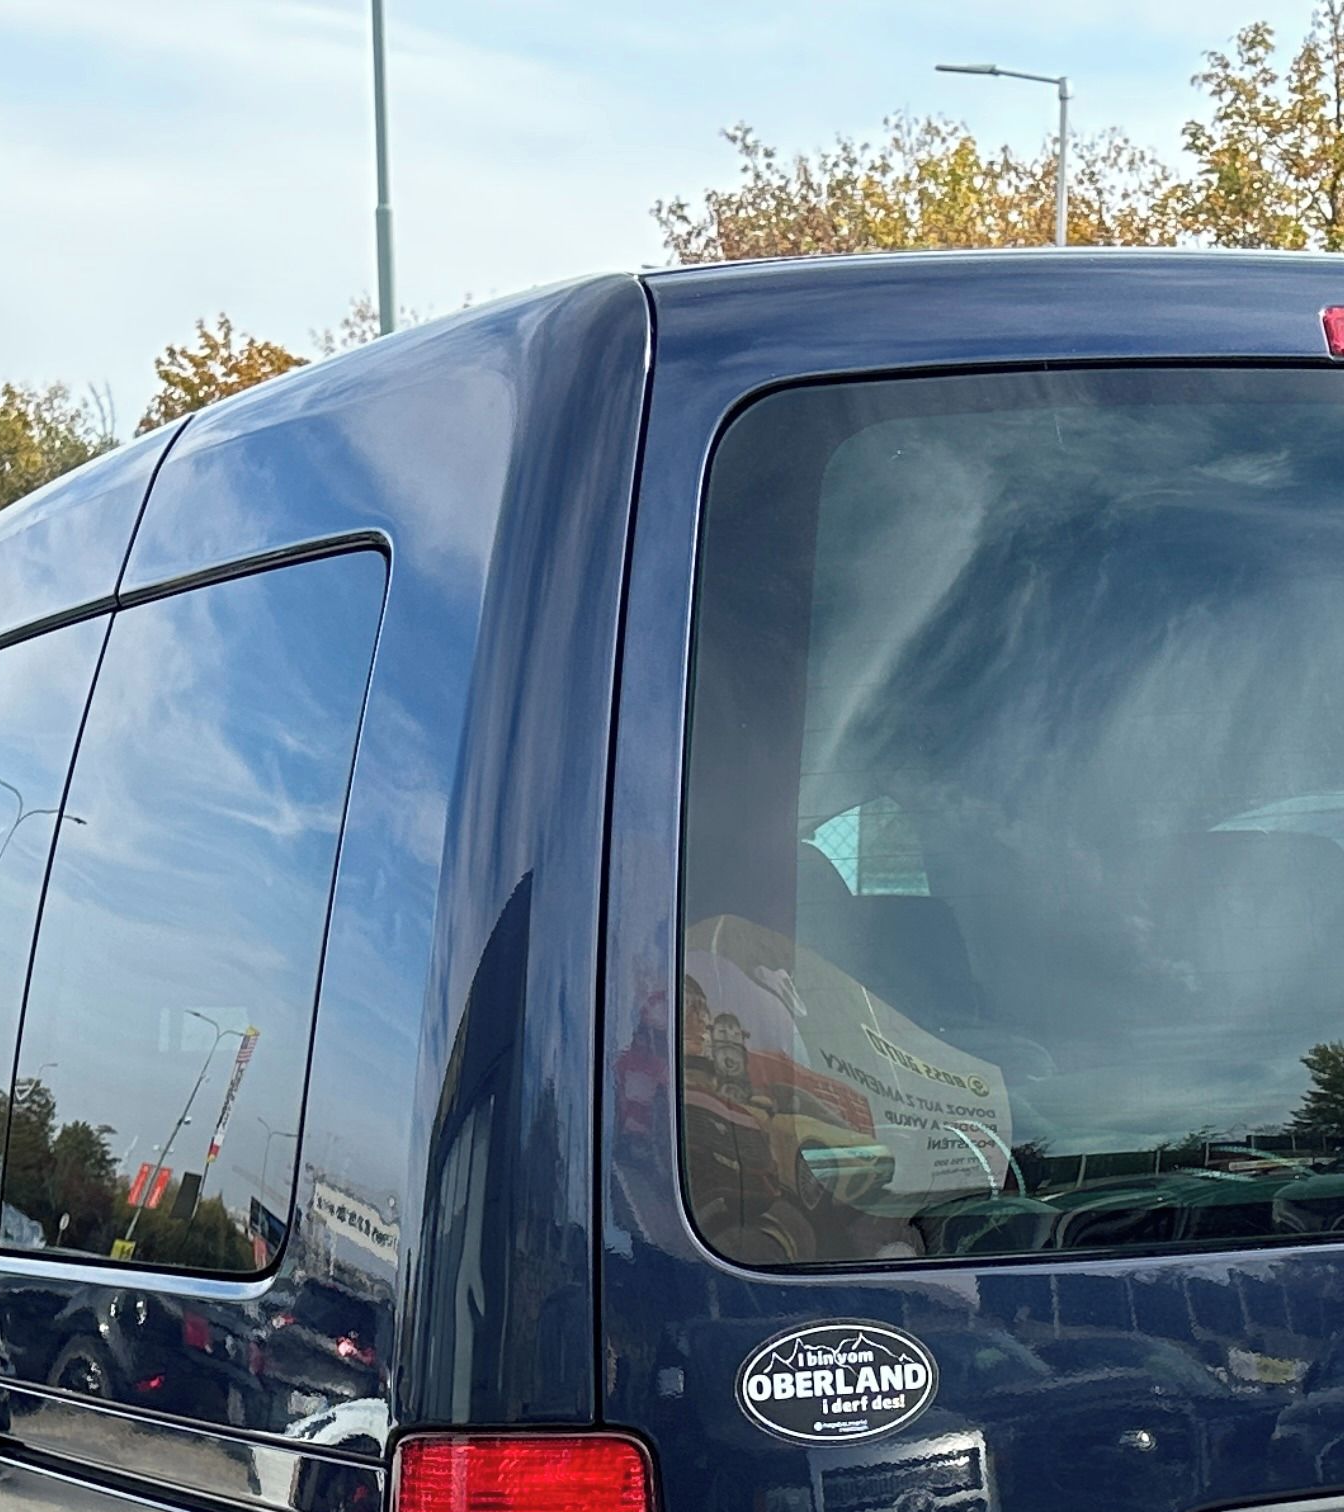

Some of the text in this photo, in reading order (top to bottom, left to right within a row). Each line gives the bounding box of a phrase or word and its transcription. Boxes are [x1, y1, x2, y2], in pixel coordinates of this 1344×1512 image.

[807, 1351, 833, 1367] bin
[835, 1351, 874, 1366] vom
[747, 1363, 926, 1401] OBERLAND
[831, 1395, 869, 1413] derf
[872, 1394, 905, 1410] des!
